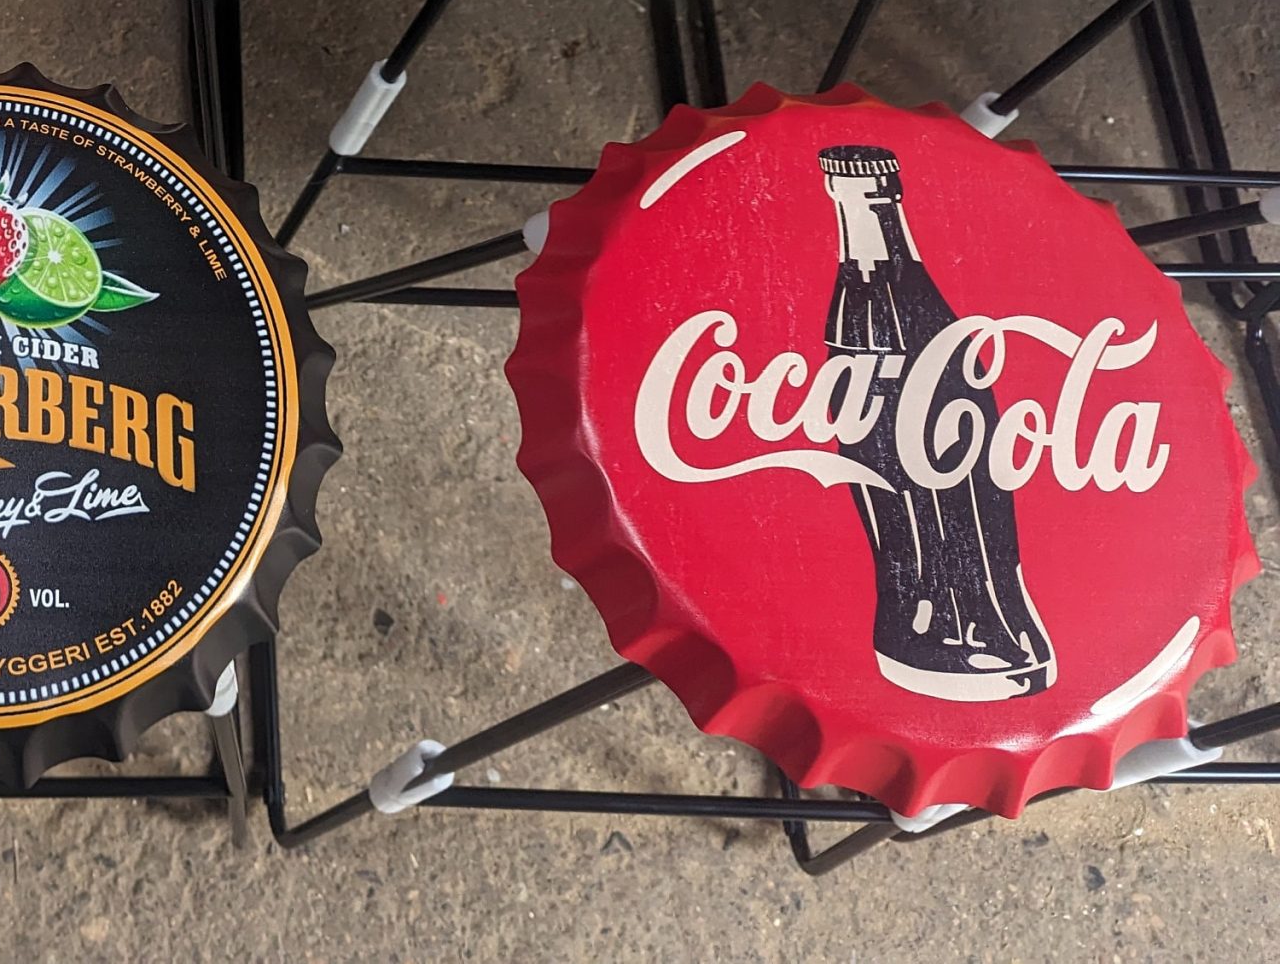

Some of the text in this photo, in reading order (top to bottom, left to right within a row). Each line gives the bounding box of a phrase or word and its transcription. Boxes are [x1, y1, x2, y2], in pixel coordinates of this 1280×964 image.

[3, 117, 16, 129] A
[19, 119, 71, 141] TASTE
[72, 134, 96, 149] OF
[95, 144, 193, 224] STRAWBERRY
[197, 238, 229, 282] LIME
[11, 335, 101, 370] CIDER
[633, 309, 1171, 494] Coca-Cola
[28, 587, 71, 609] VOL.
